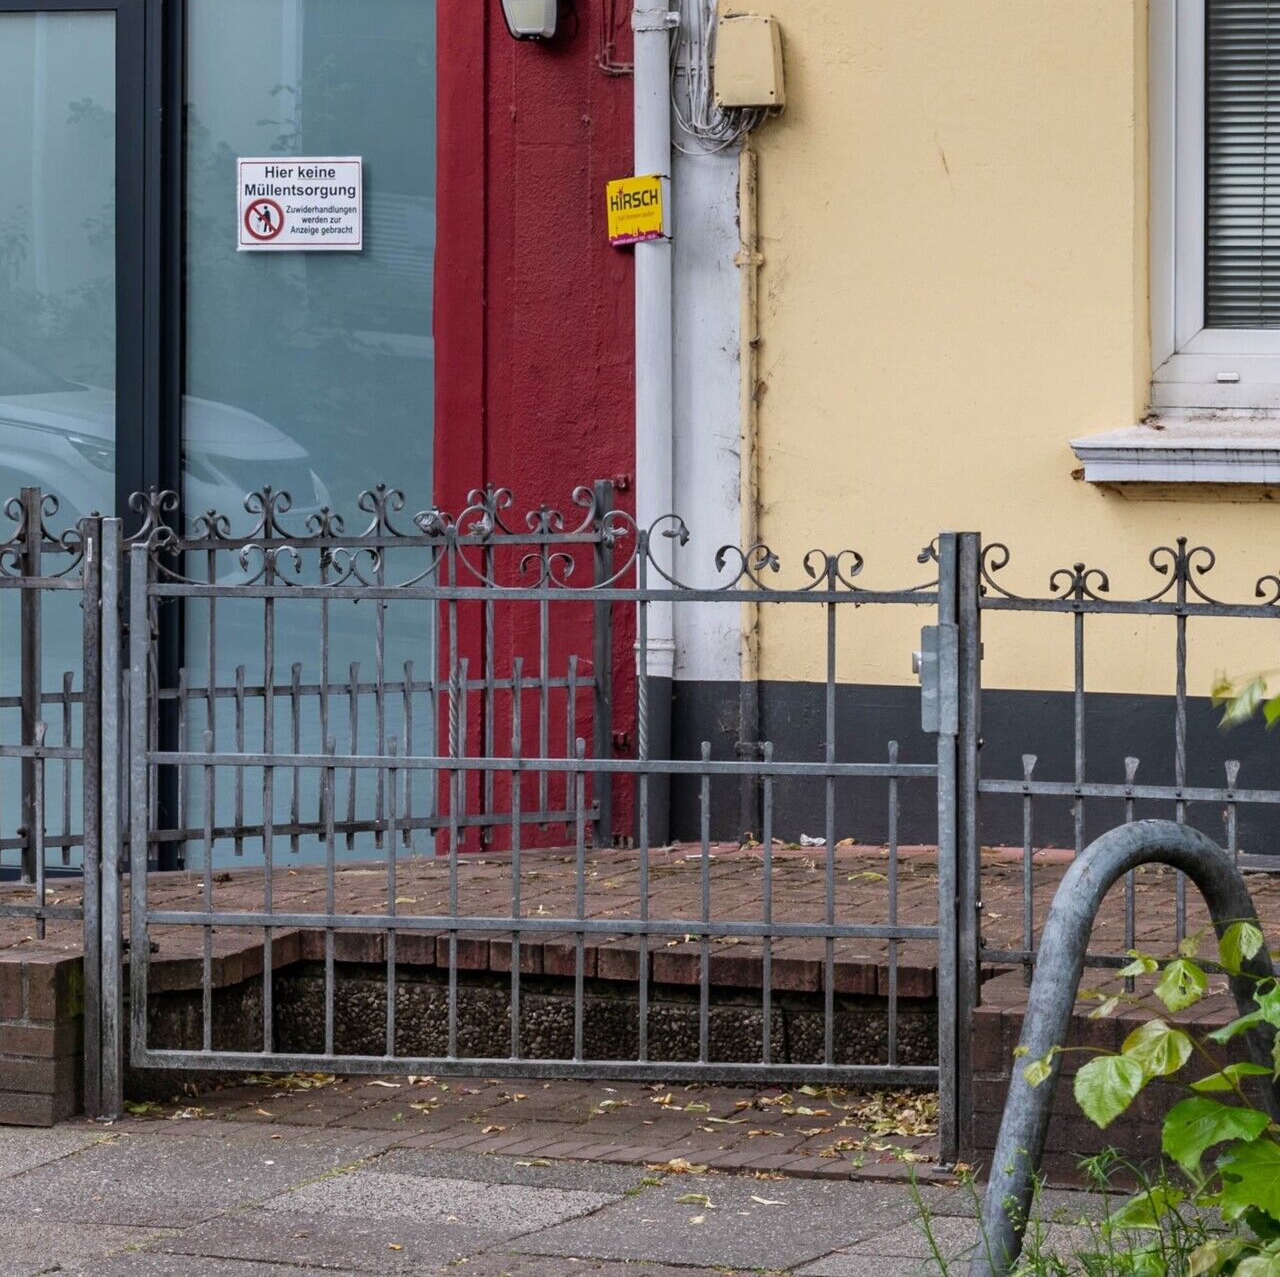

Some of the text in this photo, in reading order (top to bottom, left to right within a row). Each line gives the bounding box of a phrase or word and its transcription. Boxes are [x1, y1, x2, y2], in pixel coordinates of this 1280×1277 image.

[265, 166, 336, 179] Hier keine
[244, 184, 356, 198] Müllentsorgung
[610, 188, 658, 212] HIRSCH
[286, 205, 357, 215] Zuwiderhandlungen
[301, 216, 342, 224] werden zur
[290, 226, 353, 236] Anzeige gebracht
